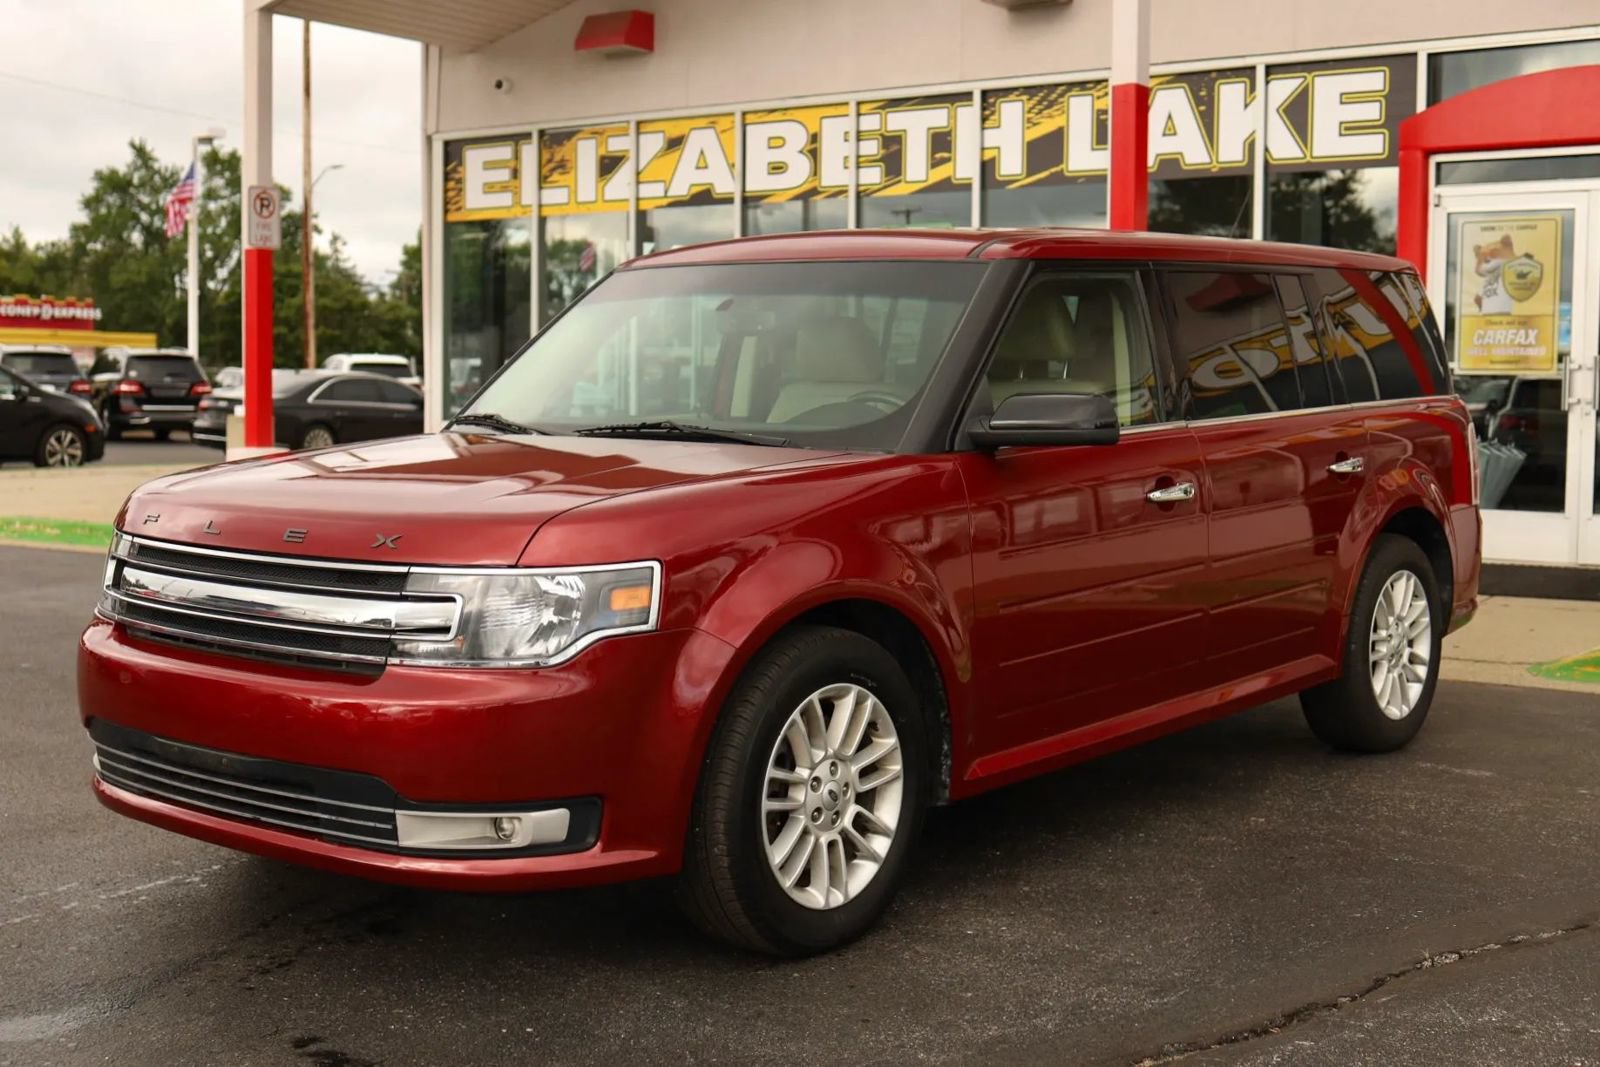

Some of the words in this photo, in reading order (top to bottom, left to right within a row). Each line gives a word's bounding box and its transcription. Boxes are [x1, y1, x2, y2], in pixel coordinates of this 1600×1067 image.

[463, 98, 1027, 210] ELIZABETH
[1063, 66, 1389, 176] LAKE
[1472, 328, 1538, 346] CARFAX
[142, 513, 403, 550] FLEX
